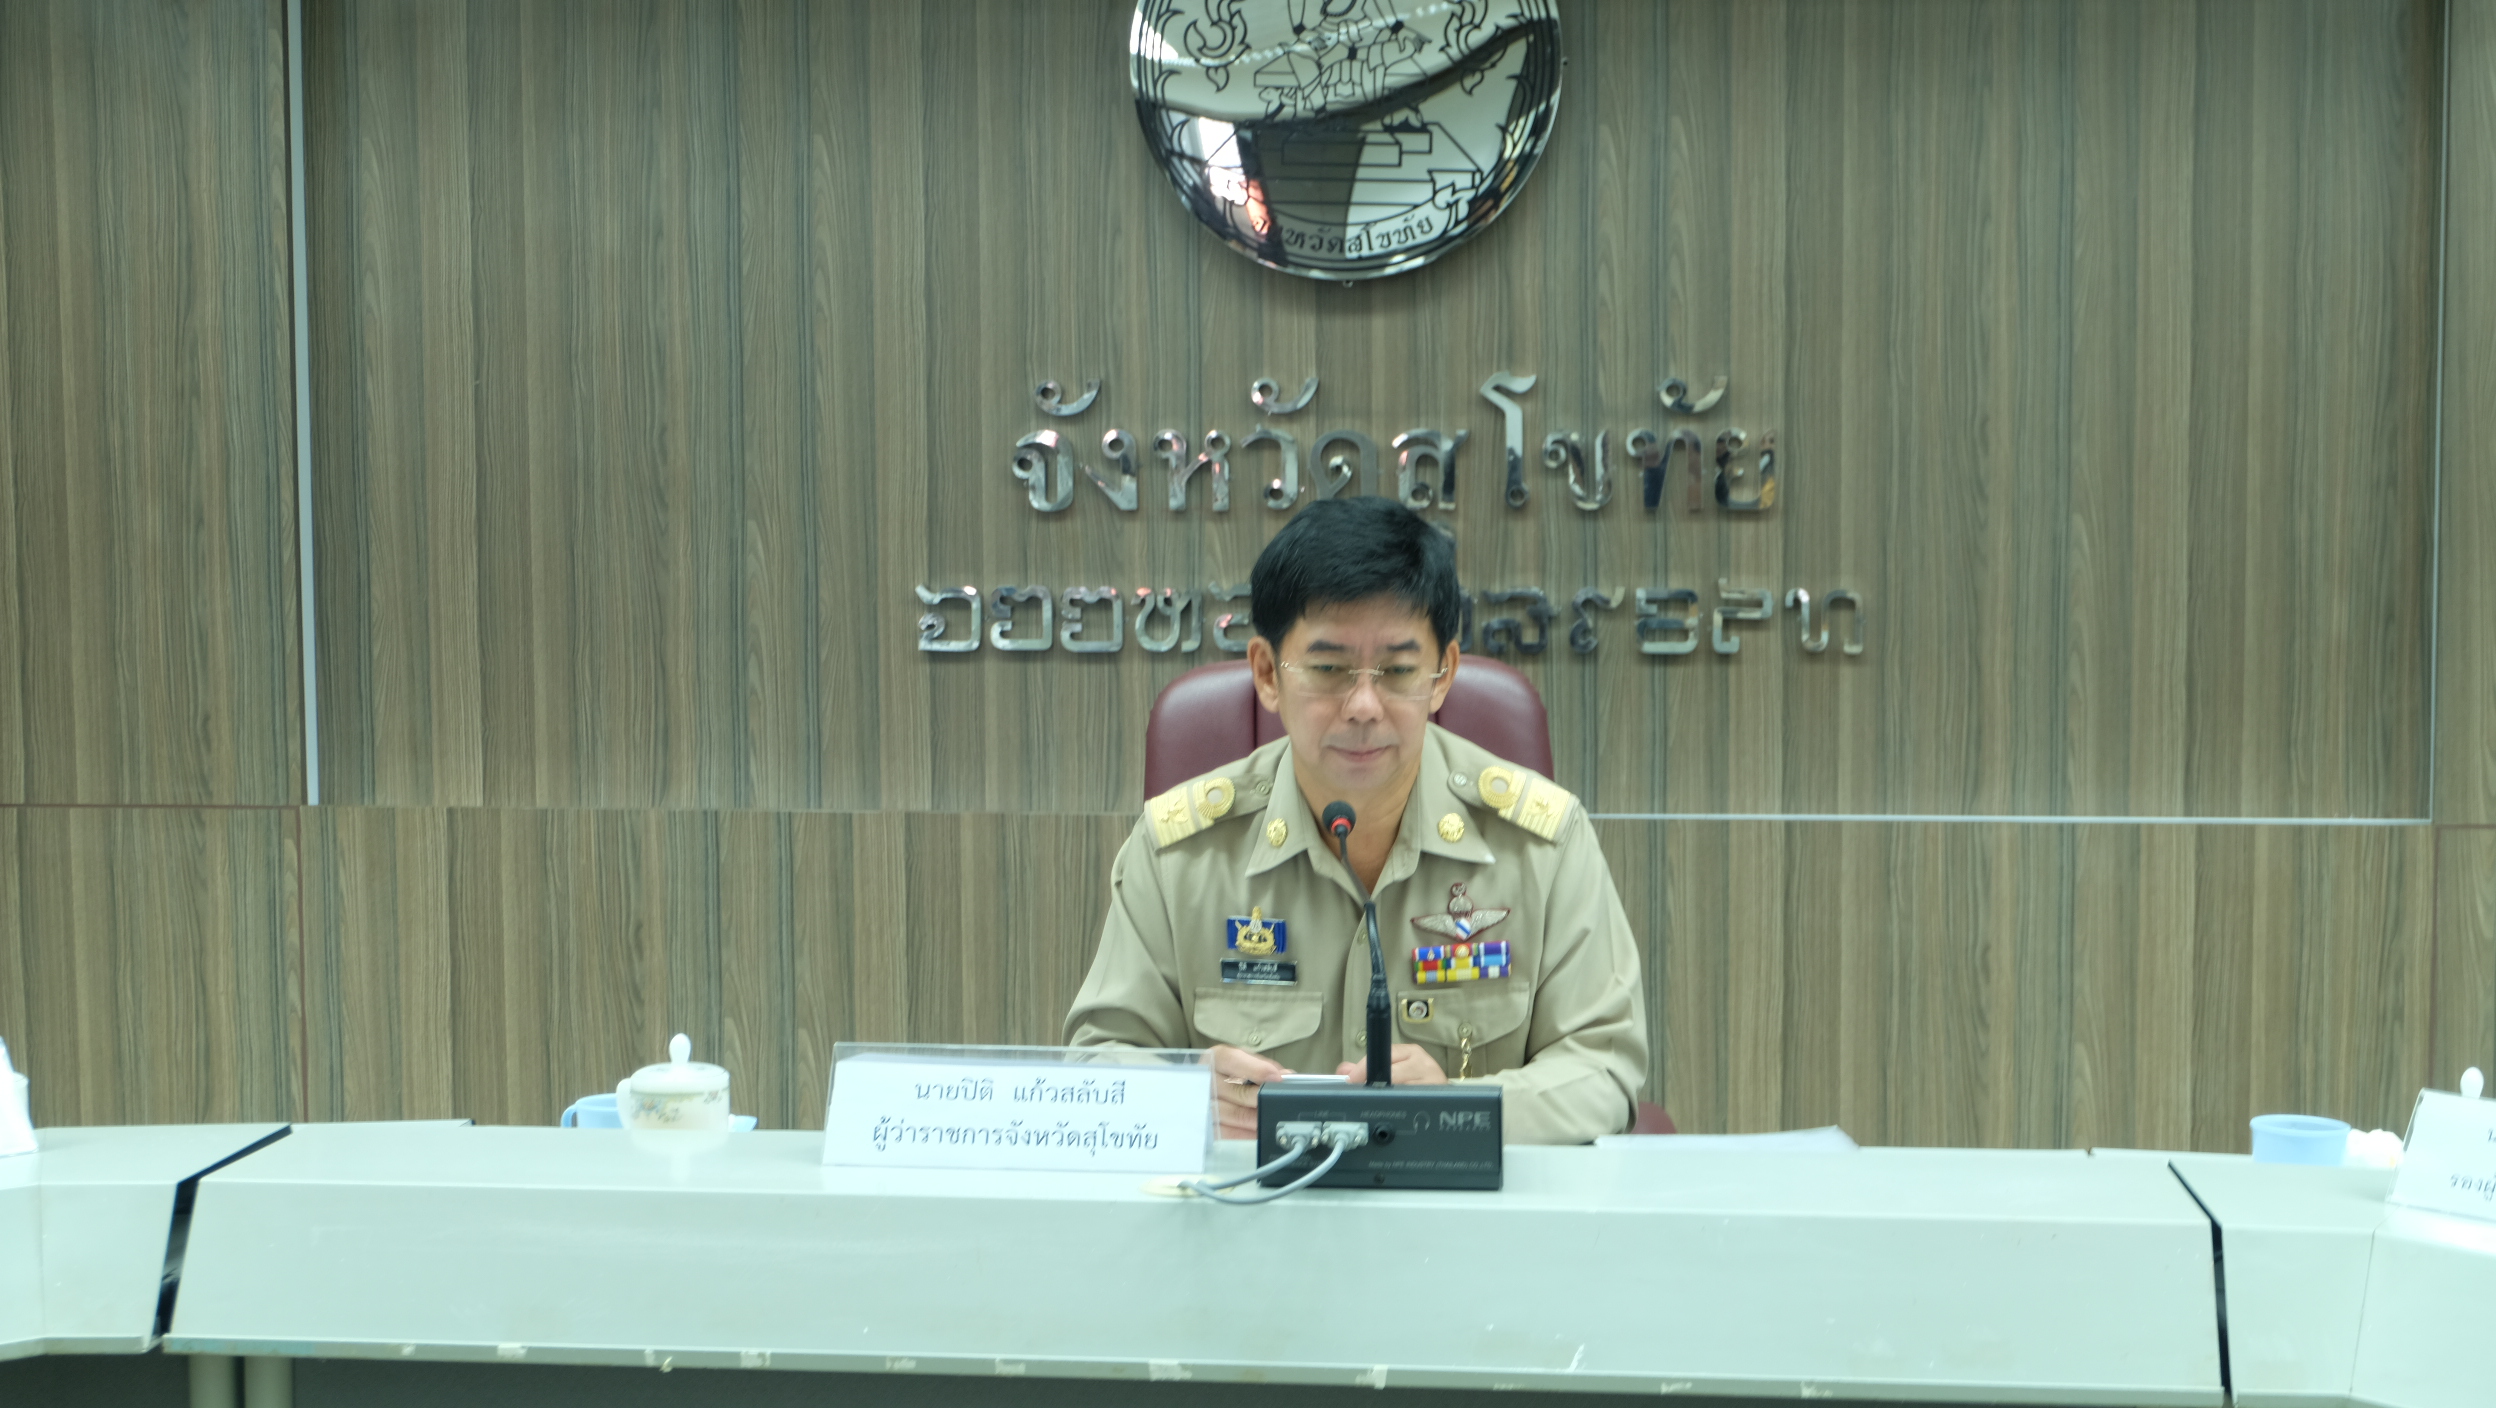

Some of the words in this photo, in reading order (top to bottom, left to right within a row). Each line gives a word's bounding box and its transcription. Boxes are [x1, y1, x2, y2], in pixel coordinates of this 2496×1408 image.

[1011, 371, 1777, 516] จังหวัดสโขทัย
[915, 1076, 994, 1101] นายปิติ
[1013, 1076, 1126, 1105] แก้วสลับสี
[1439, 1110, 1491, 1128] NPE
[873, 1115, 1159, 1157] ผู้ว่าราชการจังหวัดสุโขทัย
[2450, 1173, 2496, 1203] รองผู
